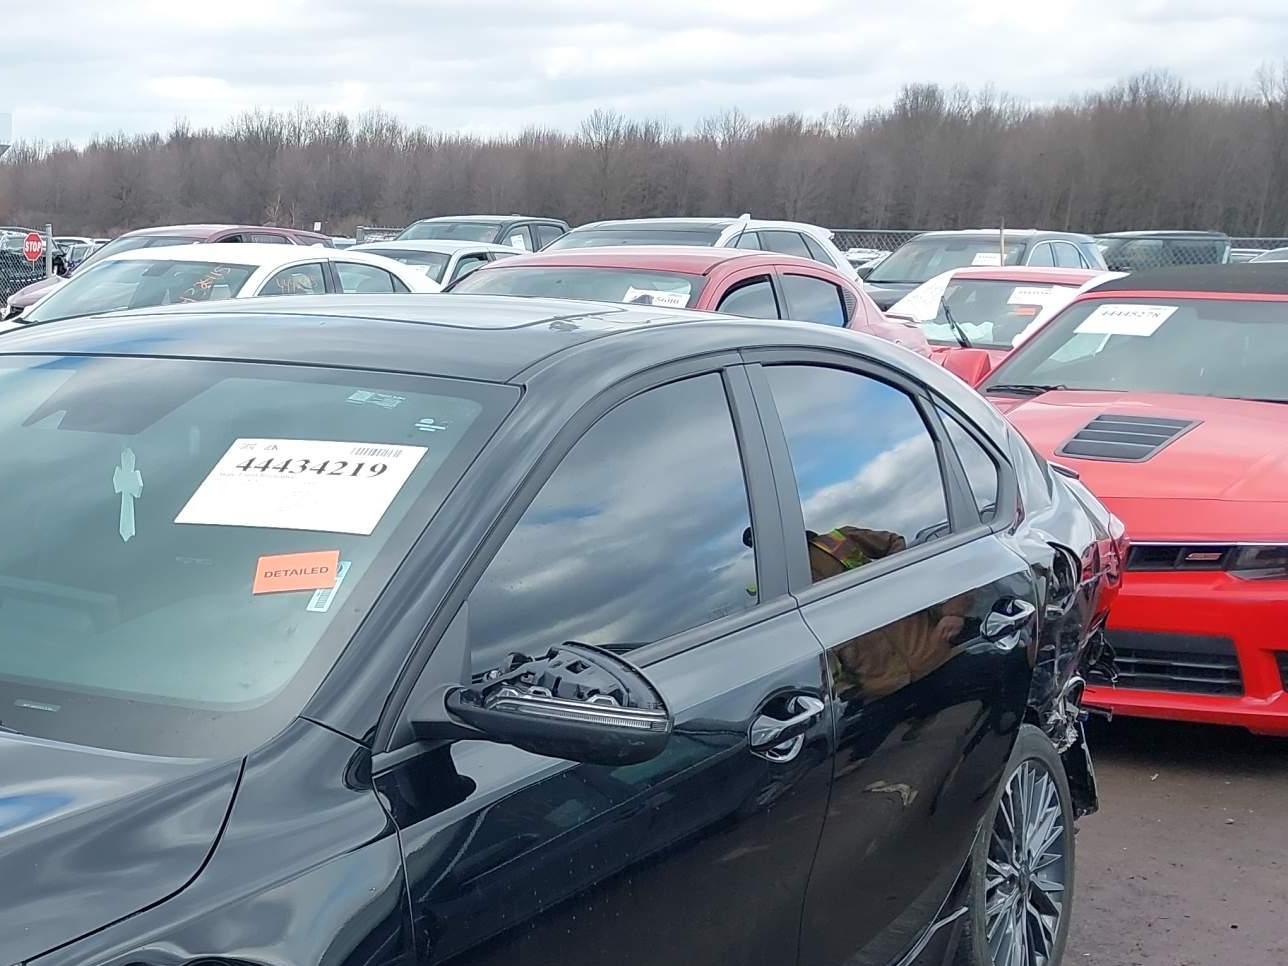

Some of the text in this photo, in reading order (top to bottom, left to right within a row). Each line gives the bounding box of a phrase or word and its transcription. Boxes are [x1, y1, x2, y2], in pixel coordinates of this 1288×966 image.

[25, 243, 42, 253] STOP
[235, 456, 389, 478] 44434219
[263, 566, 329, 579] DETAILED
